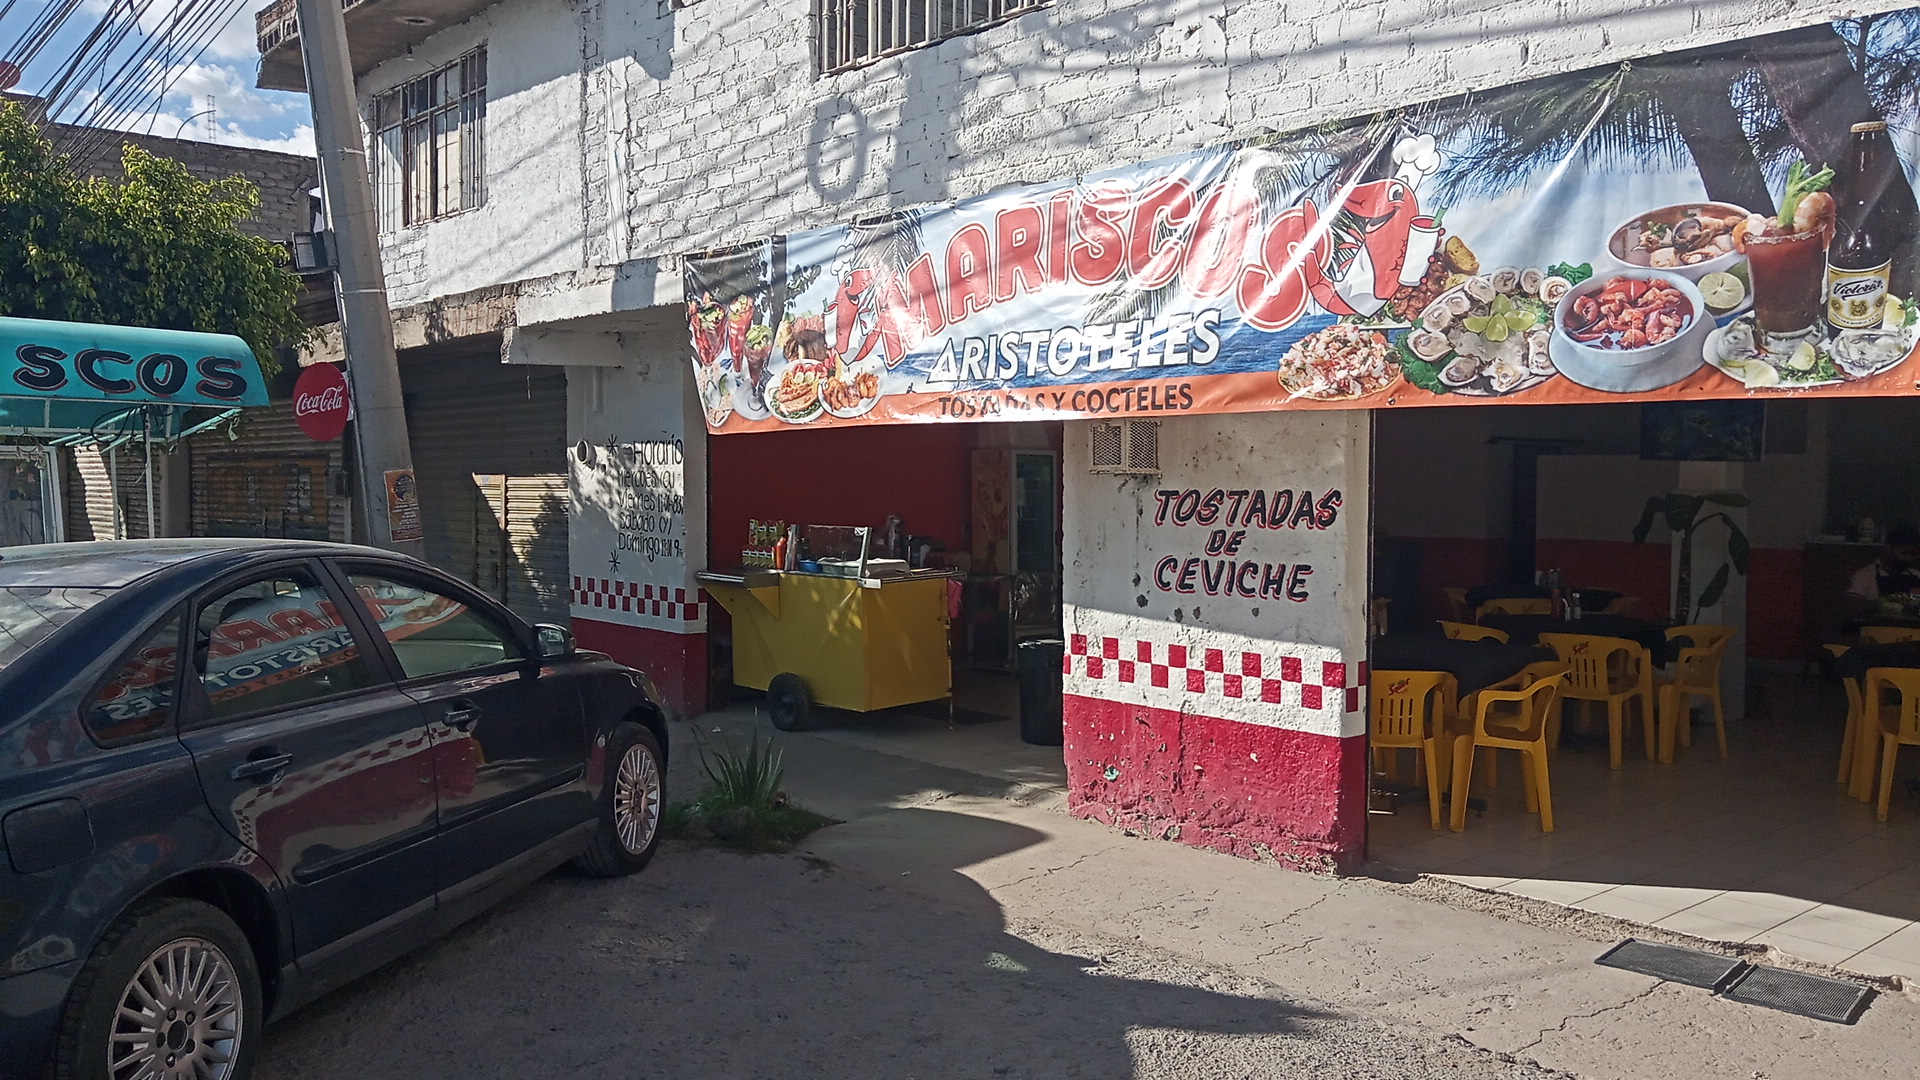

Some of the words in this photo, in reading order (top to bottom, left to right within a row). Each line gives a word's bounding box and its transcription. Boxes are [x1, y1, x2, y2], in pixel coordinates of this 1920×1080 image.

[876, 176, 1334, 368] MARISCOS
[926, 308, 1222, 384] ARISTOTELES
[1051, 391, 1067, 411] Y
[1072, 383, 1194, 413] COCTELES
[1154, 488, 1343, 530] TOSTADAS
[1204, 529, 1246, 556] DE
[1154, 555, 1314, 602] CEVICHE
